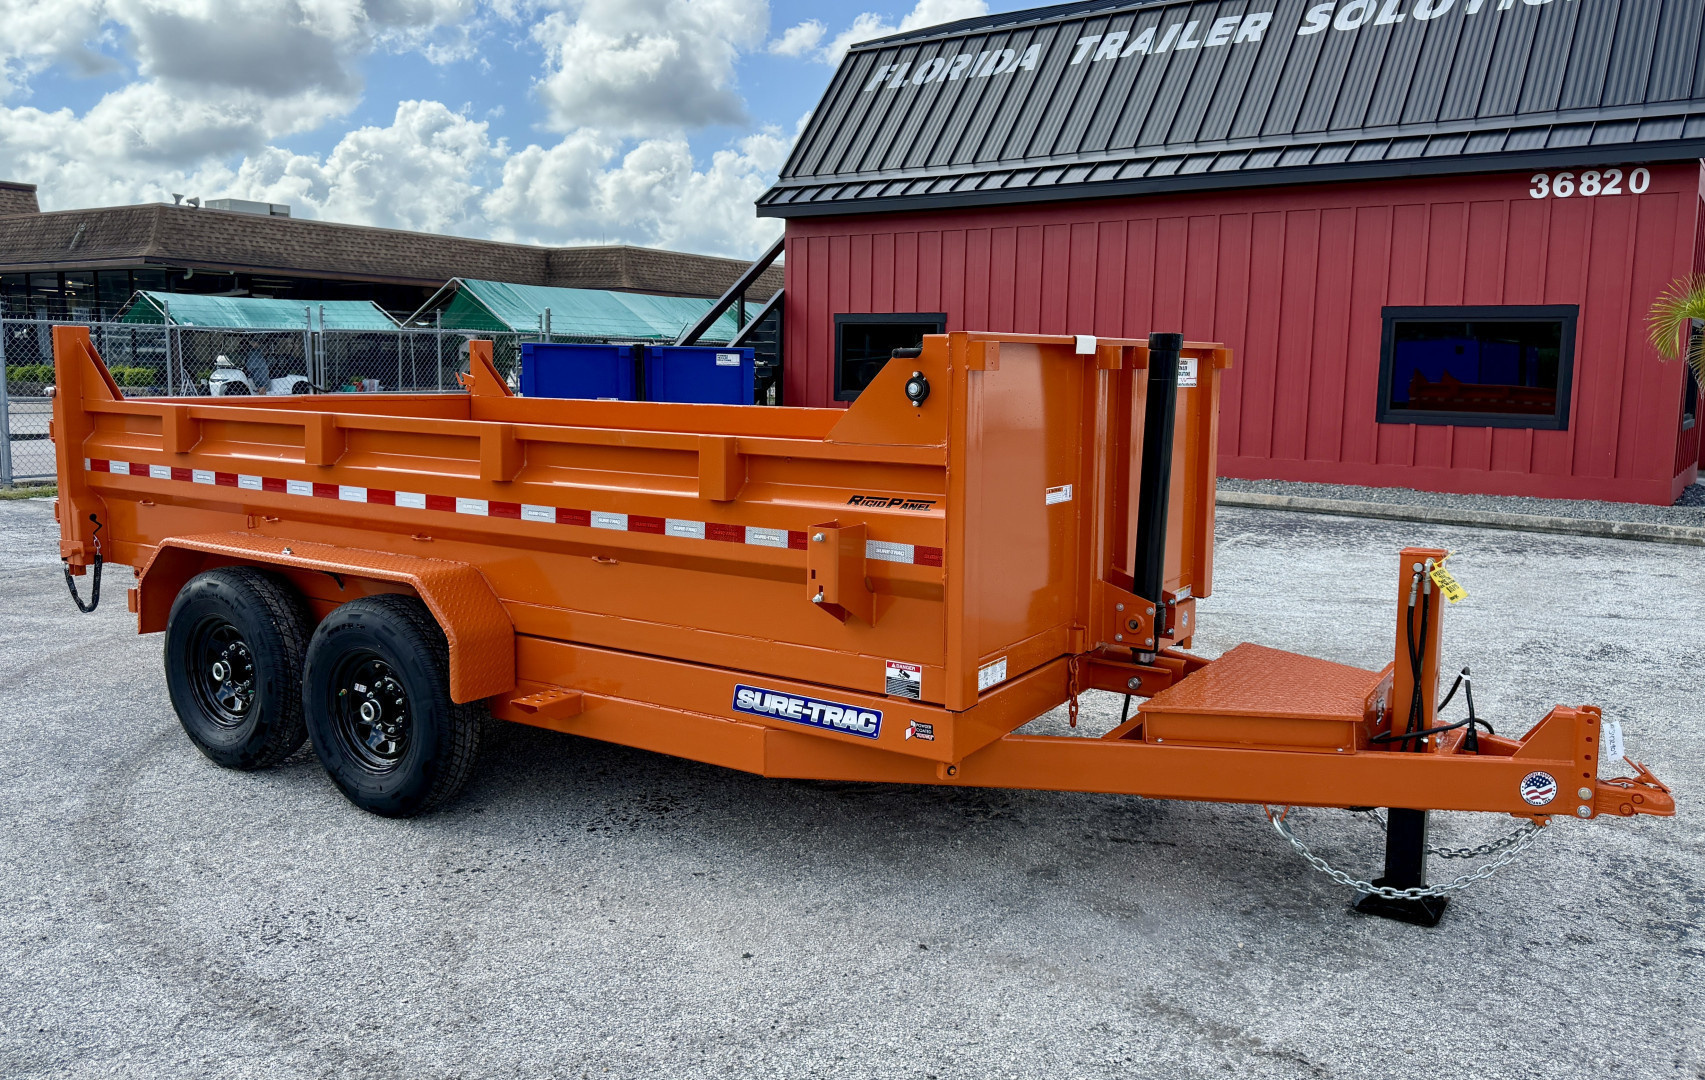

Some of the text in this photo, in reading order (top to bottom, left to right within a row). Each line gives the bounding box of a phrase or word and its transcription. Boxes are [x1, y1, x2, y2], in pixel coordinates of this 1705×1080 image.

[863, 43, 1042, 92] FLORIDA
[1070, 11, 1274, 66] TRAILER
[1529, 167, 1651, 199] 36820
[736, 688, 878, 734] SURE-TRAC
